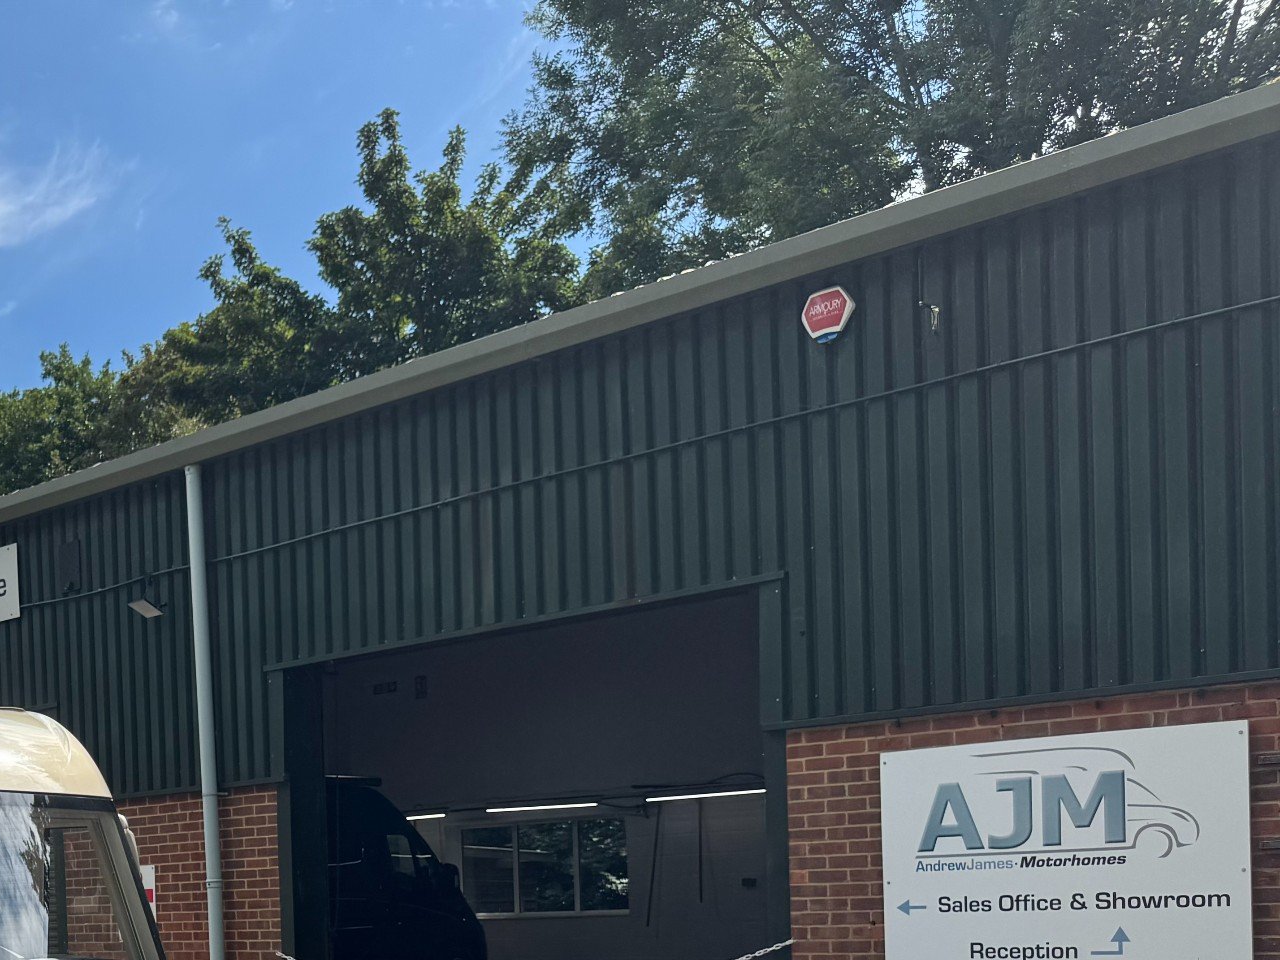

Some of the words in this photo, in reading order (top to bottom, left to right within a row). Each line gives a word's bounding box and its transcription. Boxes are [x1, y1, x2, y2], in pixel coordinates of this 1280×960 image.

[917, 769, 1126, 853] AJM
[1019, 853, 1127, 868] Motorhomes
[937, 896, 992, 913] Sales
[998, 893, 1062, 912] Office
[1069, 893, 1088, 911] &
[1095, 891, 1232, 911] Showroom
